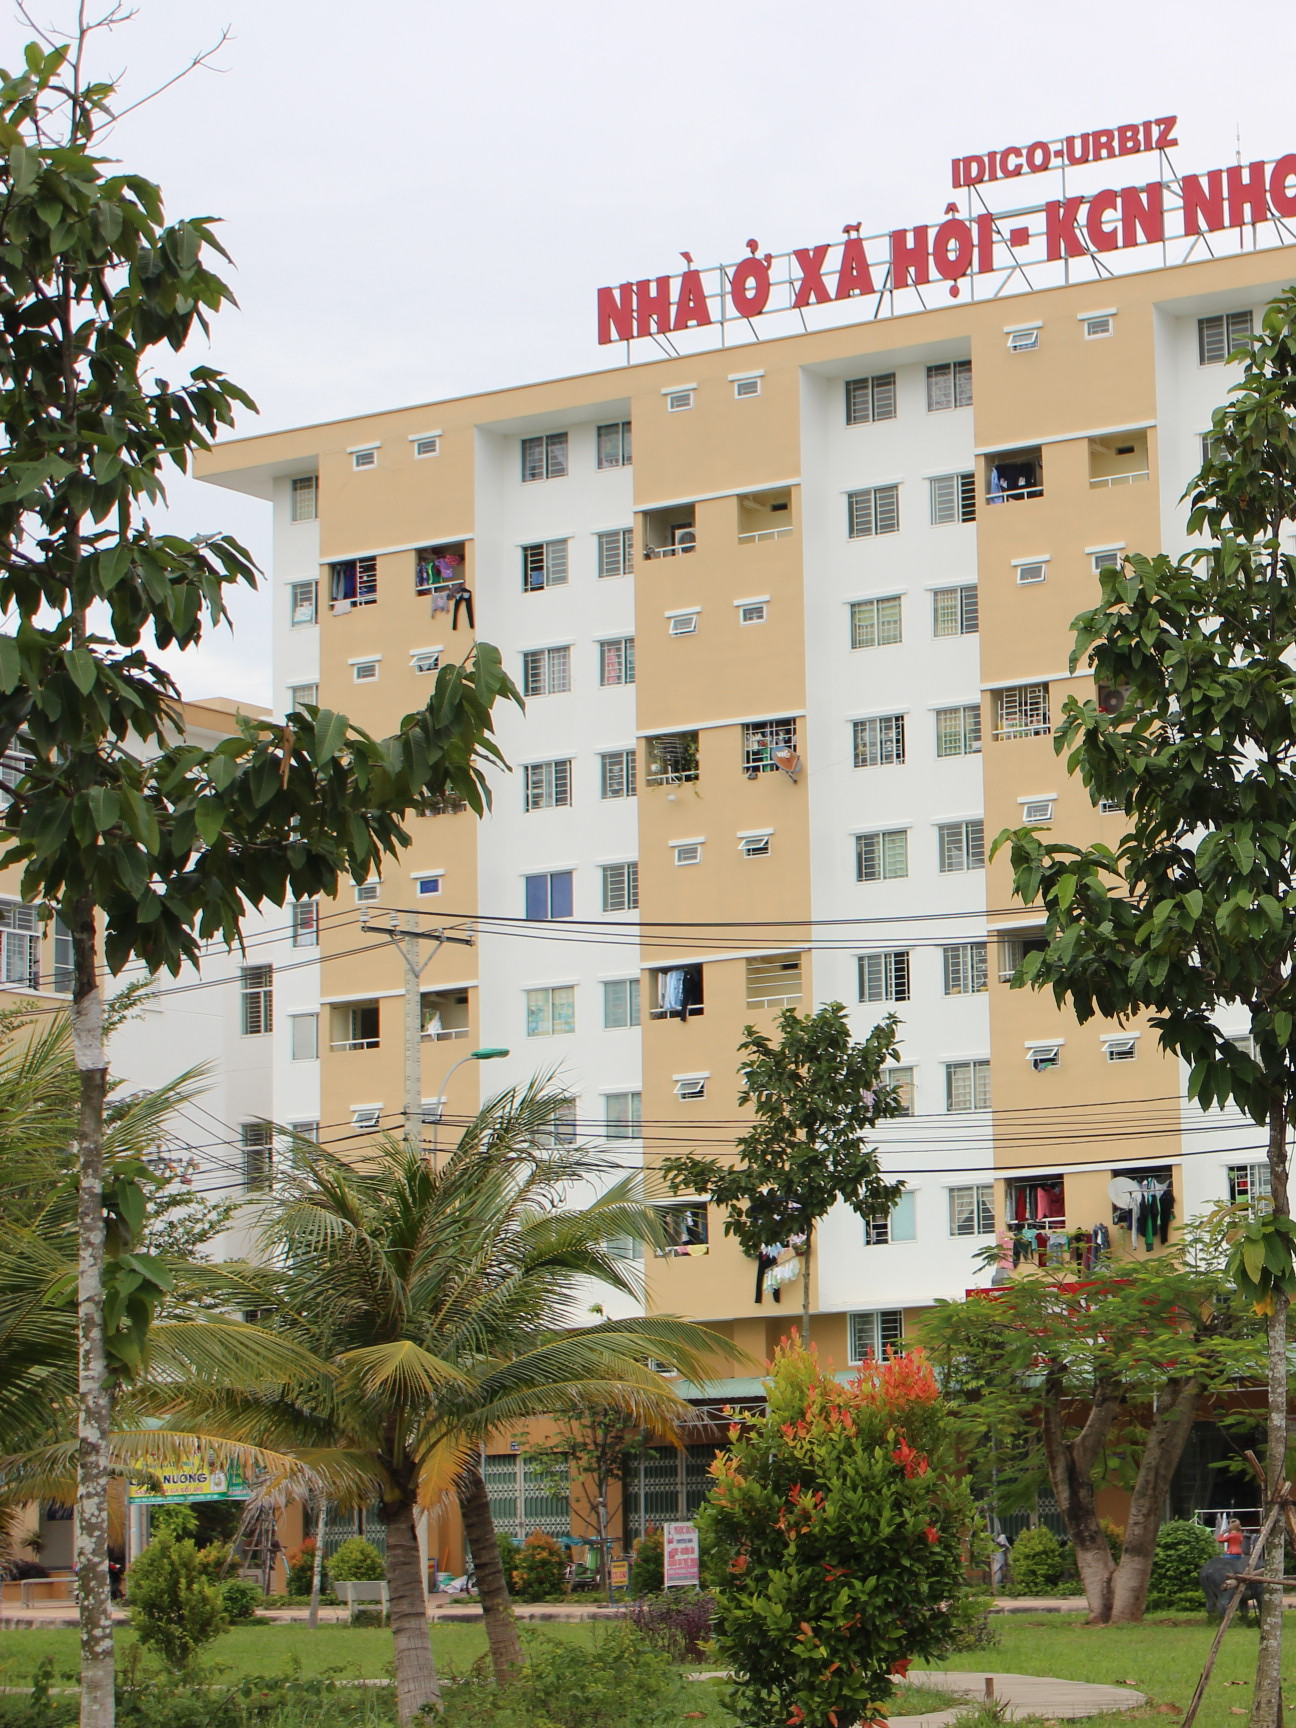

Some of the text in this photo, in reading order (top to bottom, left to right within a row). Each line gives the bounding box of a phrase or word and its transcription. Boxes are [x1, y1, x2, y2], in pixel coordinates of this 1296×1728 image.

[951, 115, 1178, 189] IDICO-URBIZ
[597, 251, 712, 345] NHÀ
[731, 238, 772, 318] Ở
[792, 222, 875, 309] XÃ
[892, 202, 994, 298] HỘI
[1045, 182, 1163, 262] KCN
